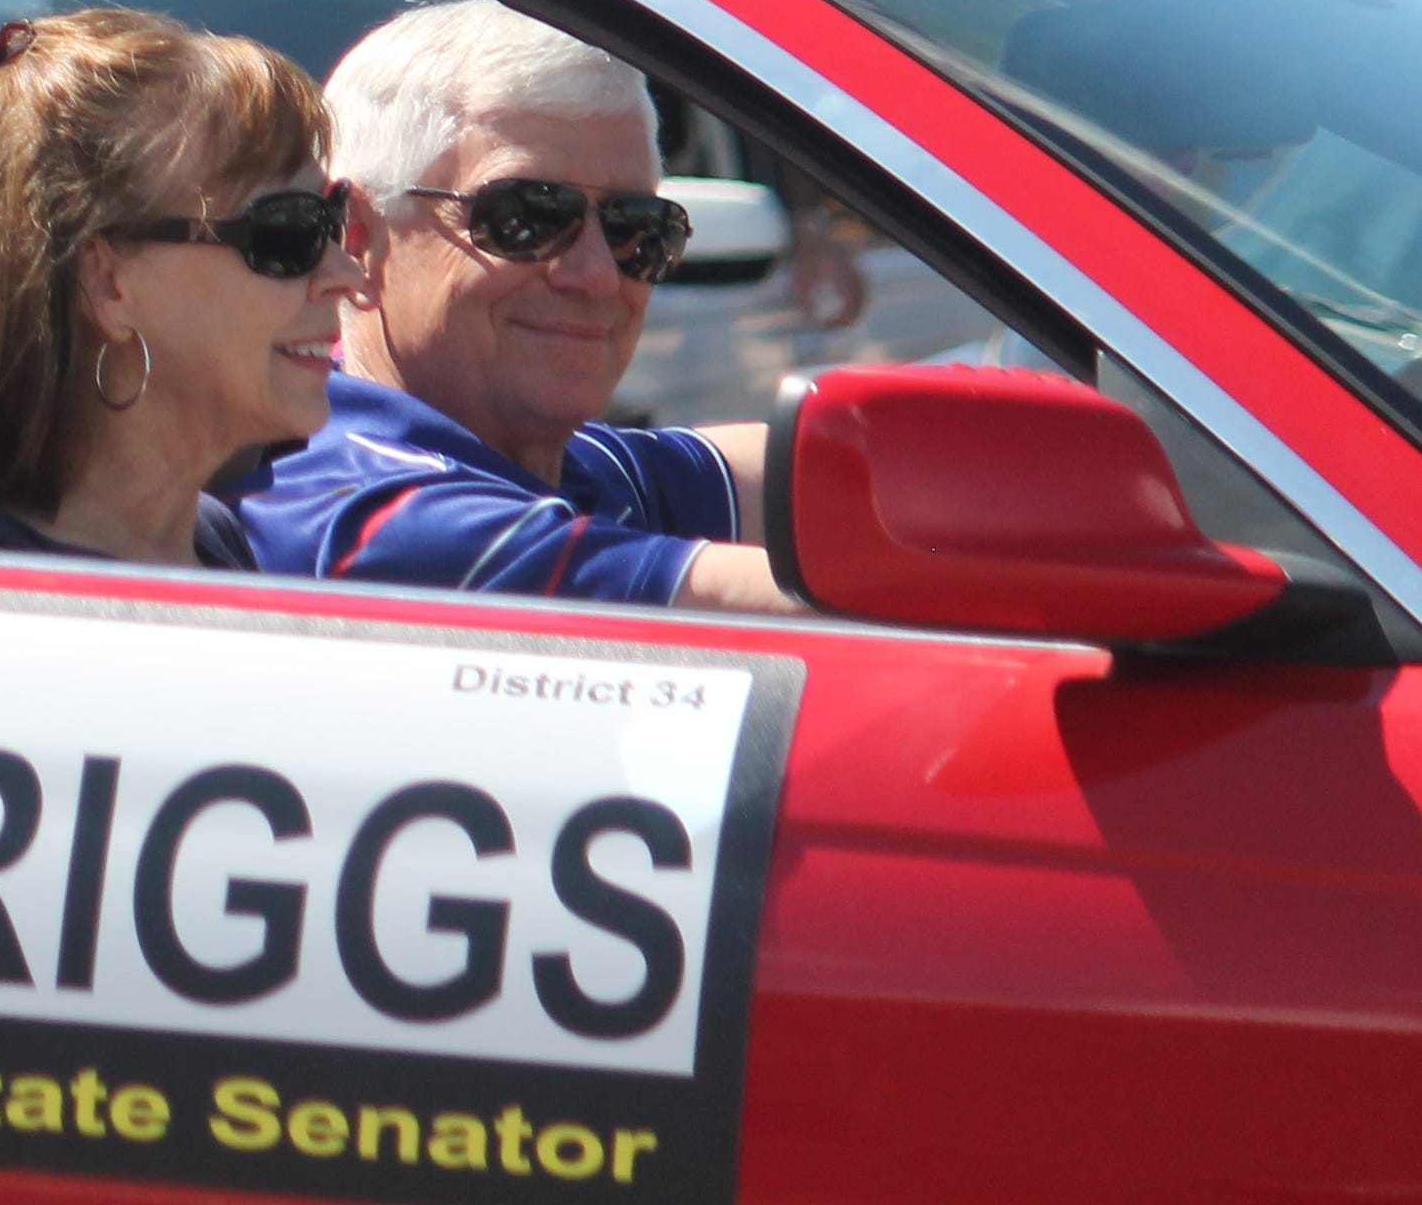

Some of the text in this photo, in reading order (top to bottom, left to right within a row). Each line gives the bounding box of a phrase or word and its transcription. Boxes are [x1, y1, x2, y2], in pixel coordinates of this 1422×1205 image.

[452, 663, 707, 710] District 34
[208, 1077, 658, 1184] Senator
